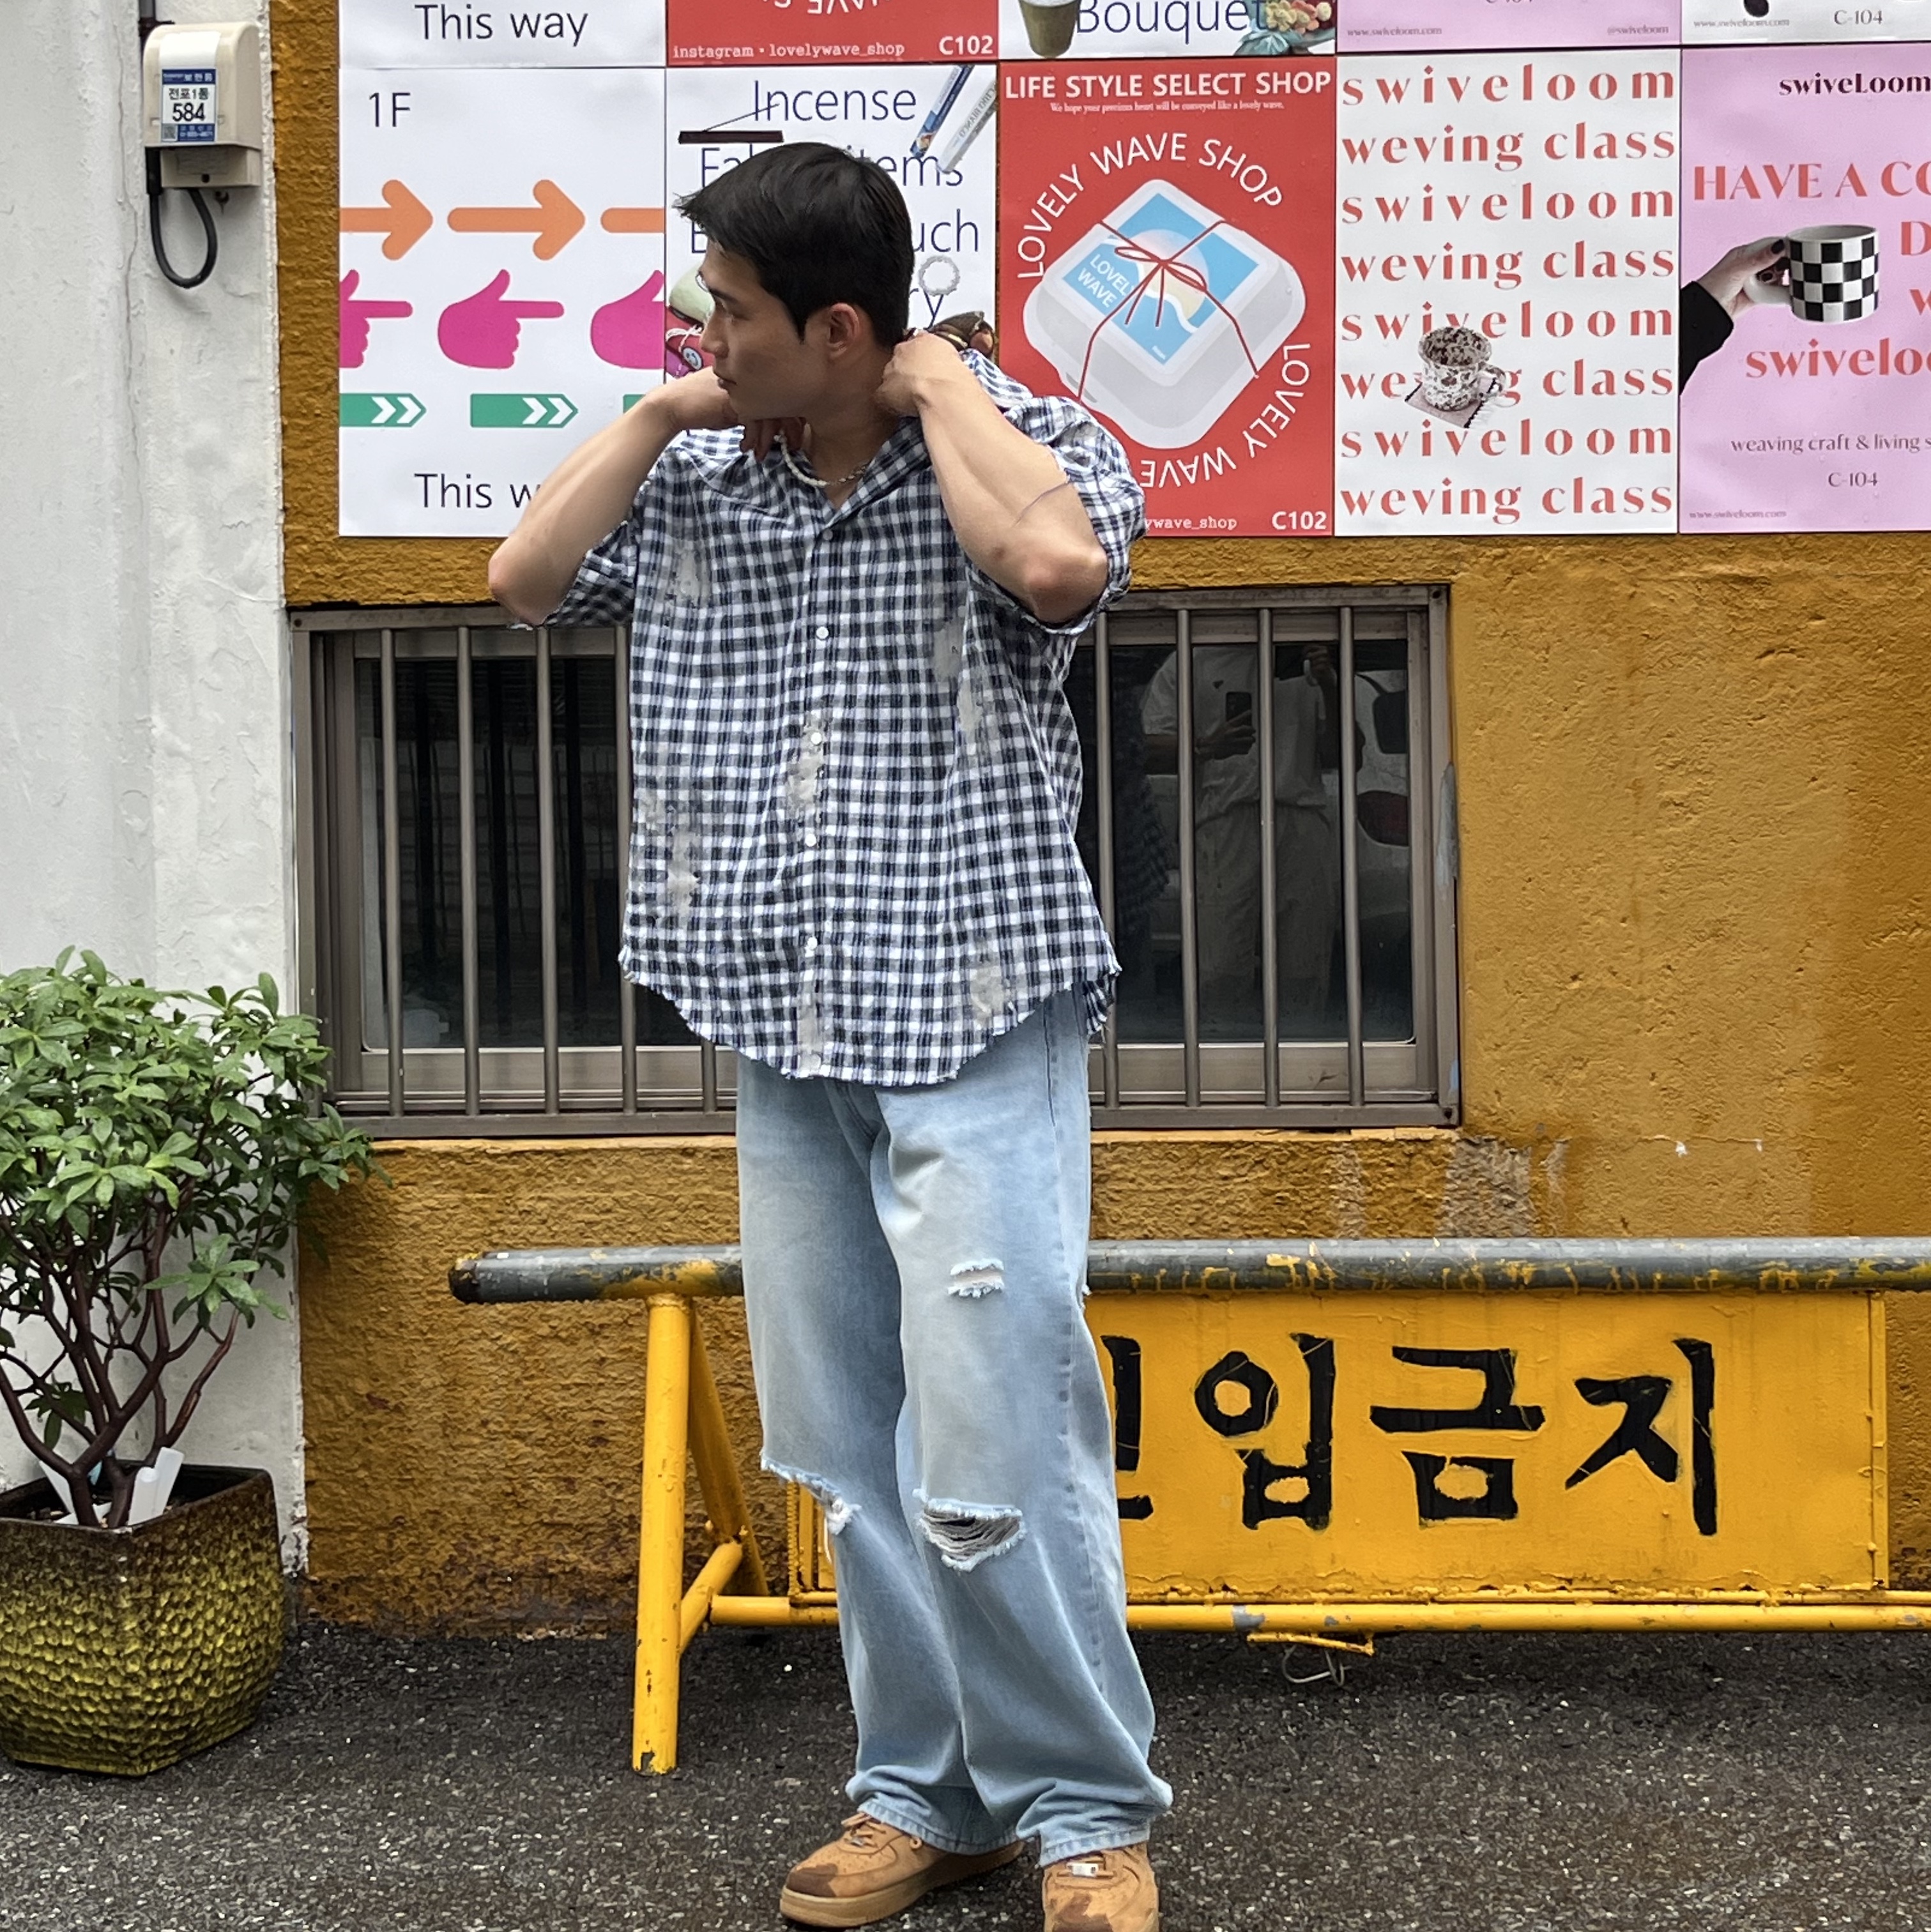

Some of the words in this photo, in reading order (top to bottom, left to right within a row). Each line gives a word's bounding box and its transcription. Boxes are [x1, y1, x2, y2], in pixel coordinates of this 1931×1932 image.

[414, 3, 493, 40] This
[510, 13, 588, 47] way
[1076, 0, 1269, 45] Bouquet
[1607, 24, 1669, 35] @swiveloom
[1834, 10, 1882, 25] C-104
[673, 45, 754, 60] instagram
[769, 42, 905, 58] lovelywave_shop
[939, 34, 993, 55] C102
[754, 80, 917, 121] Incense
[1005, 76, 1056, 98] LIFE
[1065, 74, 1143, 98] STYLE
[1152, 73, 1246, 96] SELECT
[1256, 71, 1331, 95] SHOP
[1341, 63, 1675, 106] swiveloom
[1778, 72, 1931, 96] swiveLoom
[172, 102, 206, 121] 584
[369, 92, 411, 128] 1F
[1341, 124, 1524, 172] weving
[1543, 121, 1675, 161] class
[1693, 163, 1822, 201] HAVE
[1835, 162, 1868, 198] A
[1017, 164, 1085, 279] LOVELY
[1090, 132, 1188, 176] WAVE
[1198, 138, 1283, 208] SHOP
[1341, 182, 1674, 225] swiveloom
[913, 209, 979, 252] uch
[1341, 242, 1523, 289] weving
[1543, 240, 1674, 278] class
[1077, 267, 1118, 308] WAVE
[1745, 337, 1931, 379] swivelo
[1242, 342, 1311, 459] LOVELY
[1340, 368, 1523, 409] weg
[1542, 358, 1674, 397] class
[1341, 418, 1672, 459] swiveloom
[1731, 436, 1804, 455] weaving
[1808, 433, 1851, 452] craft
[1855, 433, 1870, 451] &
[1874, 433, 1920, 454] living
[1139, 446, 1237, 489] WAVE
[1828, 472, 1878, 487] C-104
[413, 471, 493, 510] This
[1340, 478, 1522, 525] weving
[1541, 476, 1672, 515] class
[1143, 515, 1238, 531] ywave_shop
[1271, 510, 1327, 531] C102
[1100, 1332, 1718, 1535] 입금지
